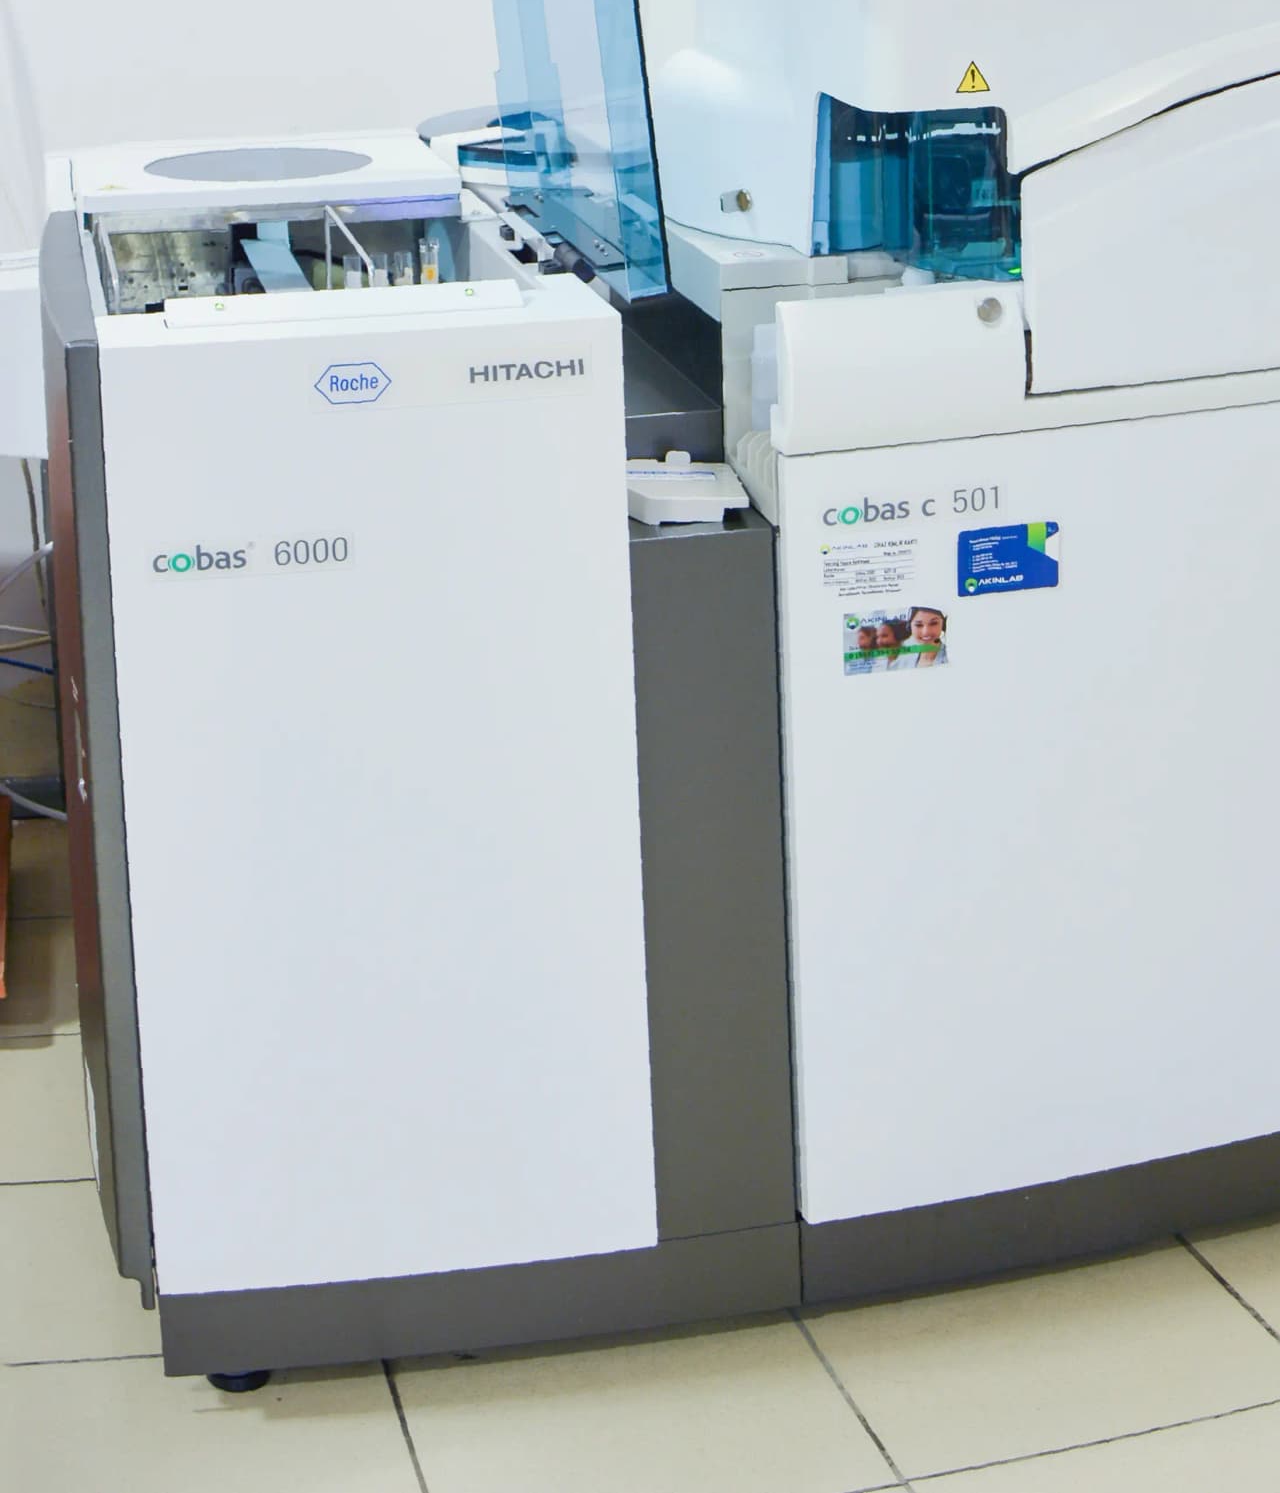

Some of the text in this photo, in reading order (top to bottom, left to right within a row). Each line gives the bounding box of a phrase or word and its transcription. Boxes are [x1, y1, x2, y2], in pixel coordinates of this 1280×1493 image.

[329, 373, 379, 393] Roche
[468, 358, 585, 384] HITACHI
[822, 485, 999, 526] cobas c 501
[152, 536, 348, 573] cobas 6000
